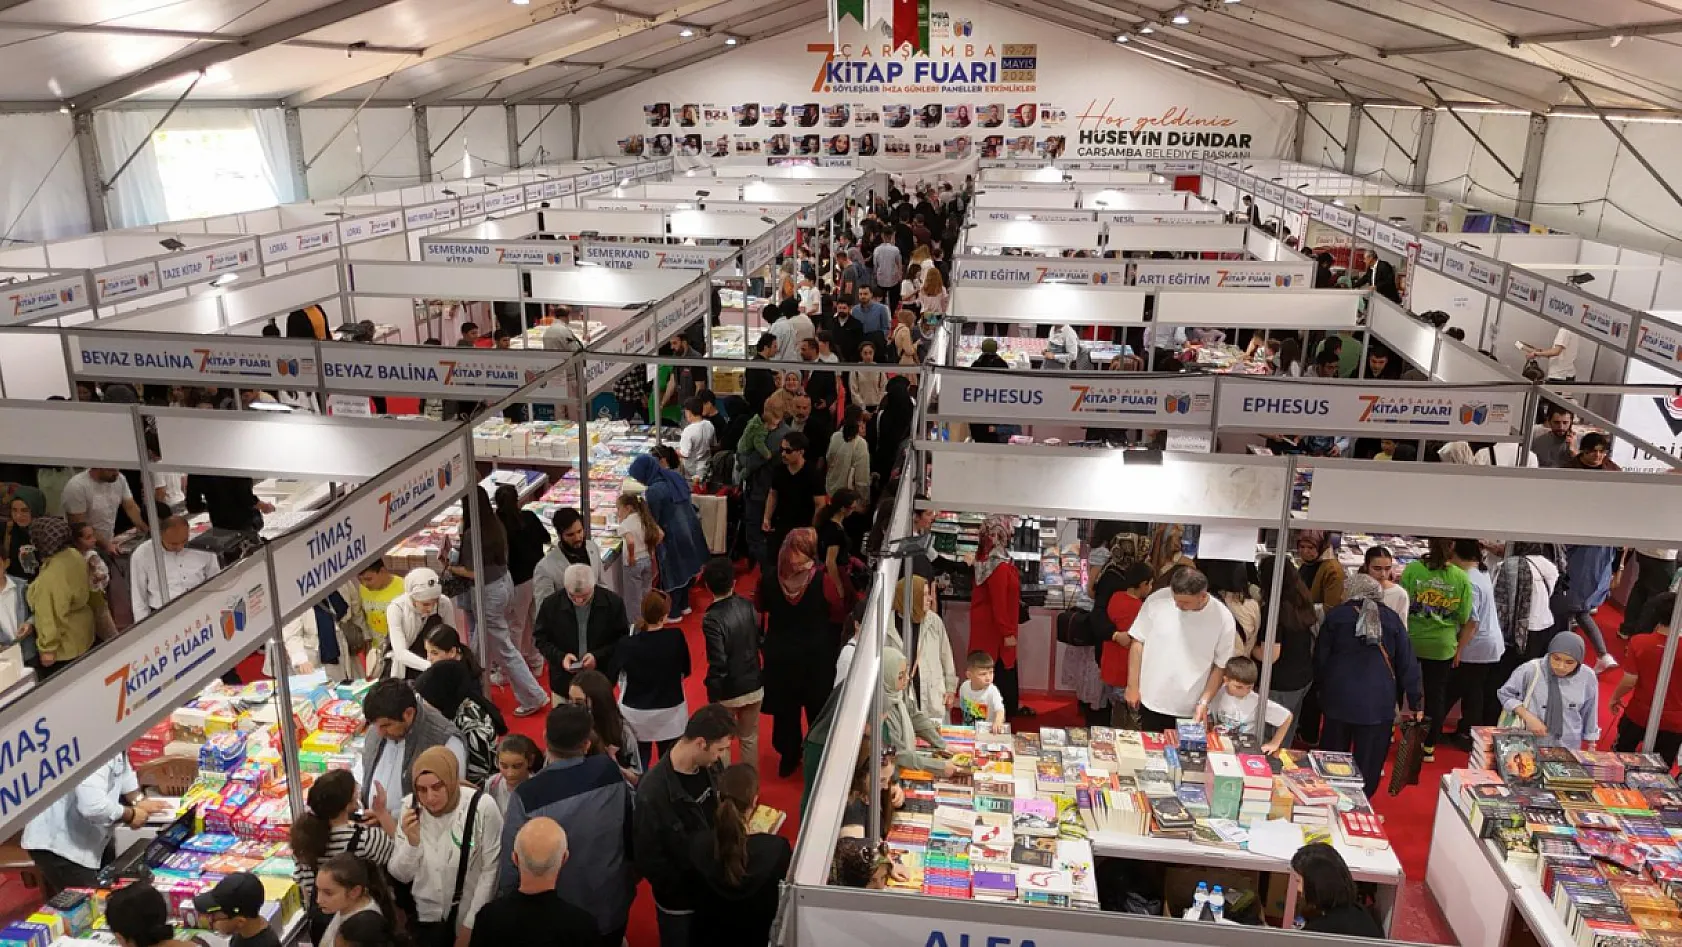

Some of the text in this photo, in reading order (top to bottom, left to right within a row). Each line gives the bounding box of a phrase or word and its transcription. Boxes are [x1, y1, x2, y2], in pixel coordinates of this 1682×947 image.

[1002, 58, 1035, 69] MAYIS
[914, 61, 997, 84] FUARI
[1002, 71, 1035, 82] 2025
[941, 85, 983, 93] PANELLER
[1132, 105, 1239, 132] geldiniz
[1079, 129, 1252, 149] HÜSEYİN DÜNDAR
[428, 245, 490, 255] SEMERKAND
[586, 248, 650, 259] SEMERKAND
[962, 268, 1030, 282] ARTI EĞİTİM
[1138, 271, 1210, 285] ARTI EĞİTİM
[81, 350, 194, 369] BEYAZ BALİNA
[239, 358, 271, 368] FUARI
[324, 362, 374, 378] BEYAZ
[378, 364, 439, 382] BALİNA
[486, 369, 519, 380] FUARI
[963, 387, 1044, 405] EPHESUS
[1121, 395, 1158, 406] FUARI
[1242, 397, 1329, 415] EPHESUS
[1412, 406, 1452, 416] FUARI
[413, 475, 435, 500] FUARI
[307, 516, 353, 560] TİMAŞ
[296, 535, 367, 598] YAYINLARI
[173, 623, 214, 663] FUARI
